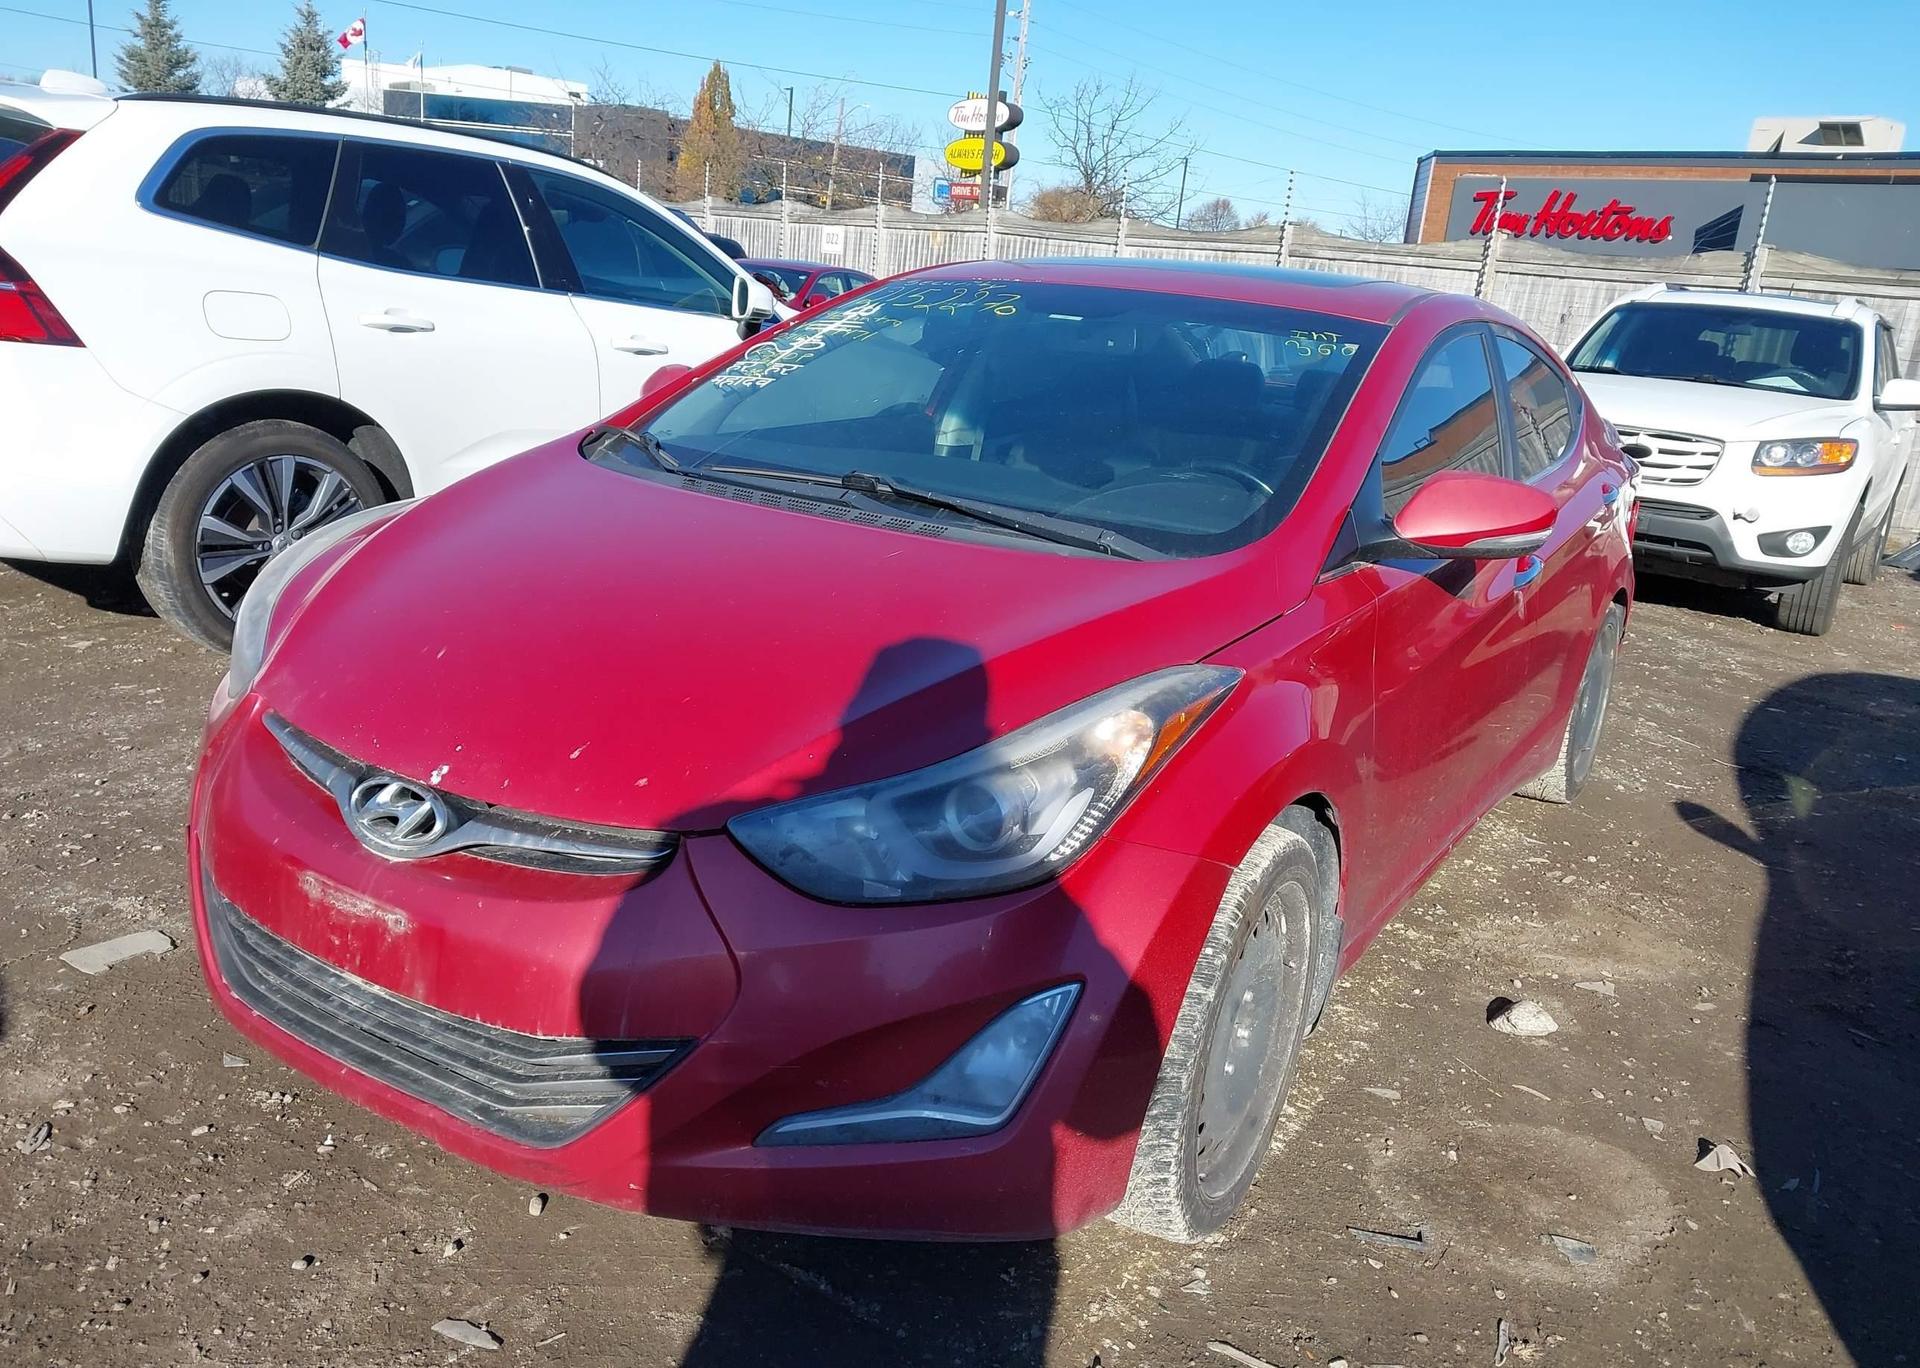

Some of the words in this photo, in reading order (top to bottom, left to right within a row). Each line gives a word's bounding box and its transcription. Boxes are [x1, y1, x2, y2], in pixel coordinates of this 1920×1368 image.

[953, 105, 970, 123] Tim
[948, 148, 975, 159] ALWAYS
[951, 186, 971, 196] DRIVE
[1469, 190, 1530, 238] Tim
[1529, 189, 1675, 243] Hortons
